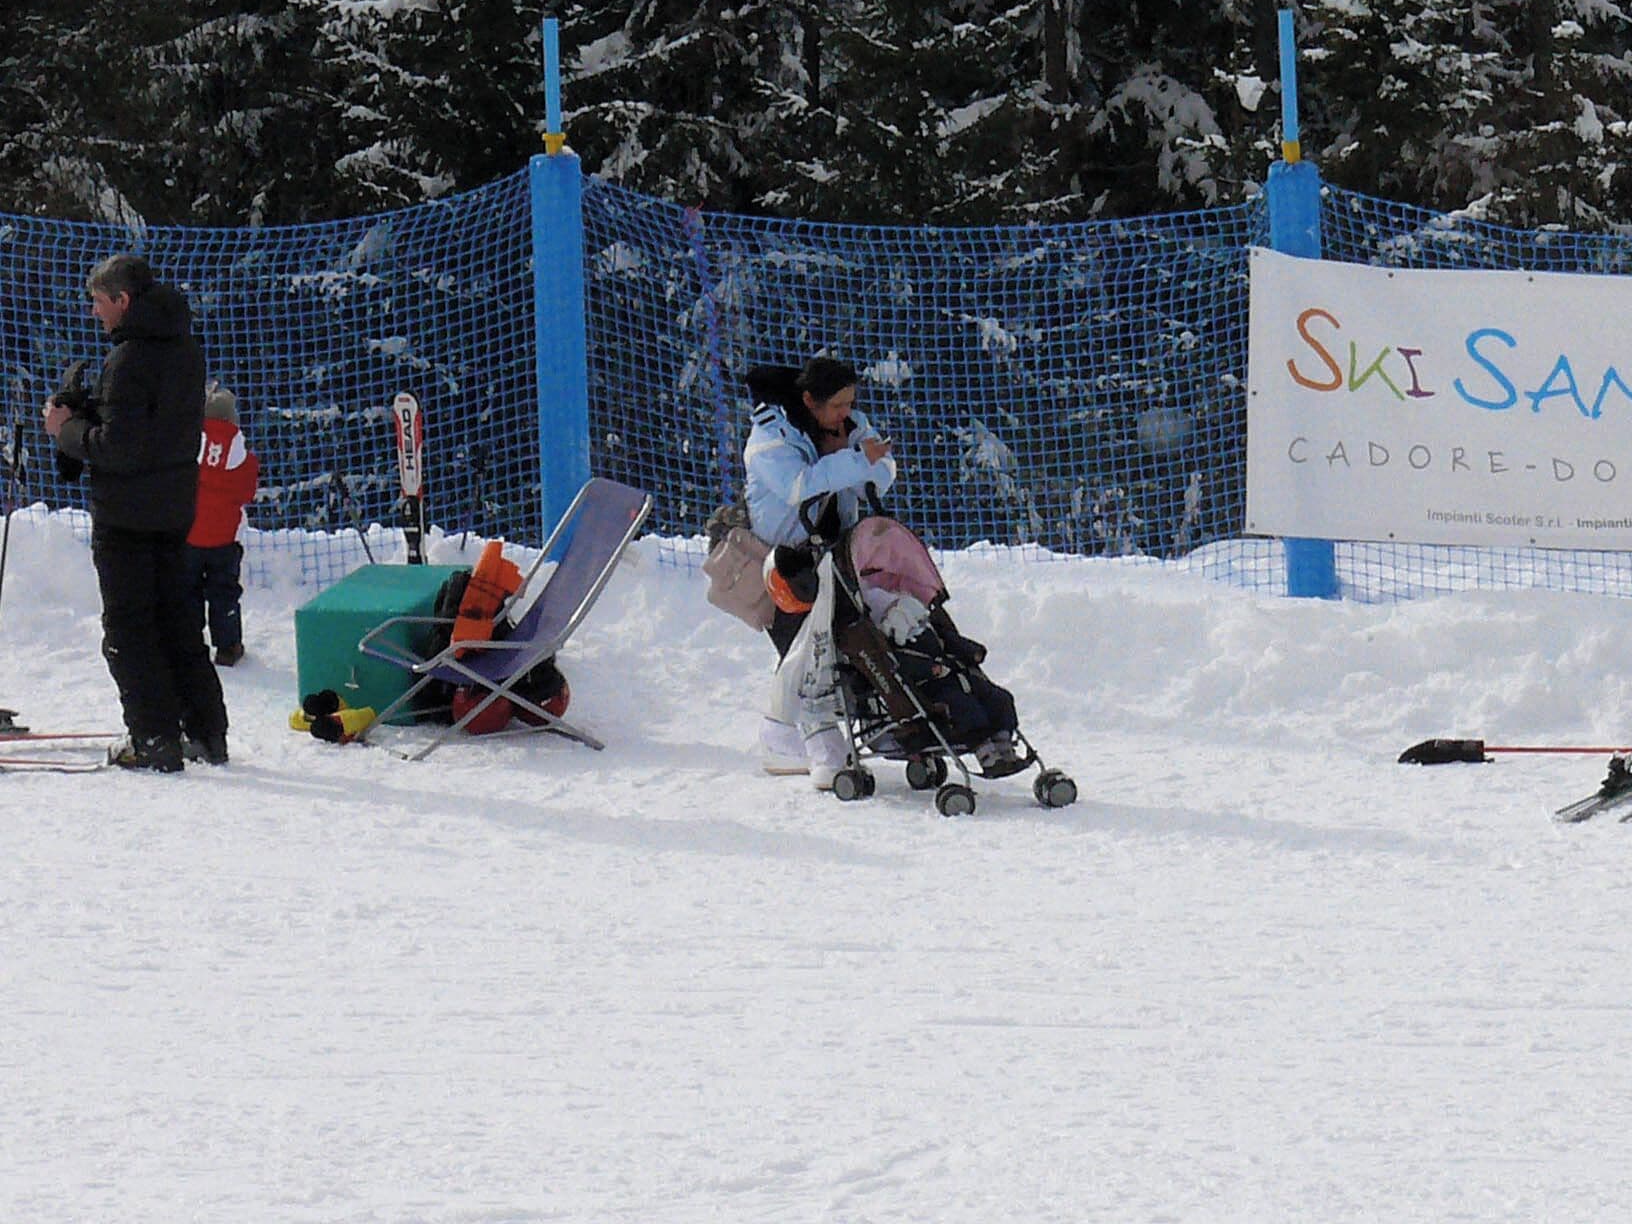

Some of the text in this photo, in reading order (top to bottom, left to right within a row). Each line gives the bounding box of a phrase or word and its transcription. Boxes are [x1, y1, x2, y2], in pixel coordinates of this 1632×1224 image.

[1286, 308, 1435, 401] SKI
[402, 408, 414, 471] HEAD
[1426, 509, 1483, 524] Impianti
